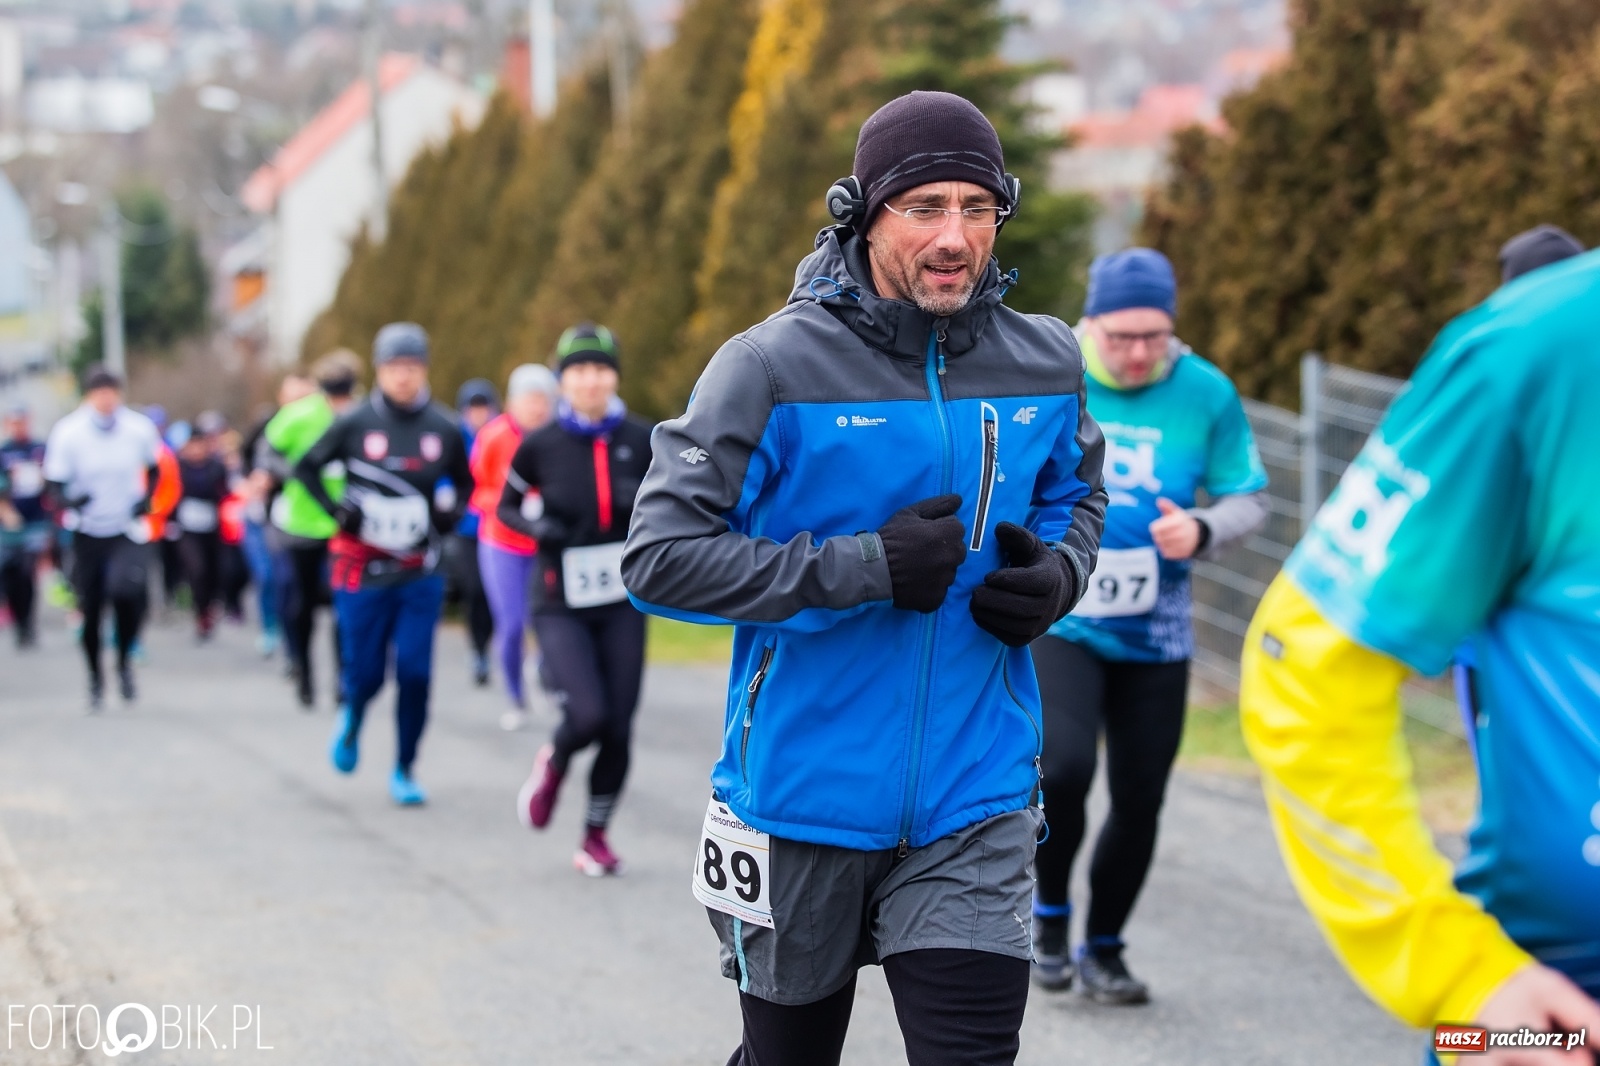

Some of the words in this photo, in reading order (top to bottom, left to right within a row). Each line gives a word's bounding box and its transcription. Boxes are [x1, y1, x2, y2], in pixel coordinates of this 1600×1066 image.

[1012, 406, 1038, 425] 4F
[679, 446, 710, 465] 4F
[1099, 574, 1148, 604] 97
[711, 812, 764, 836] personalbest.p
[695, 837, 762, 903] 89
